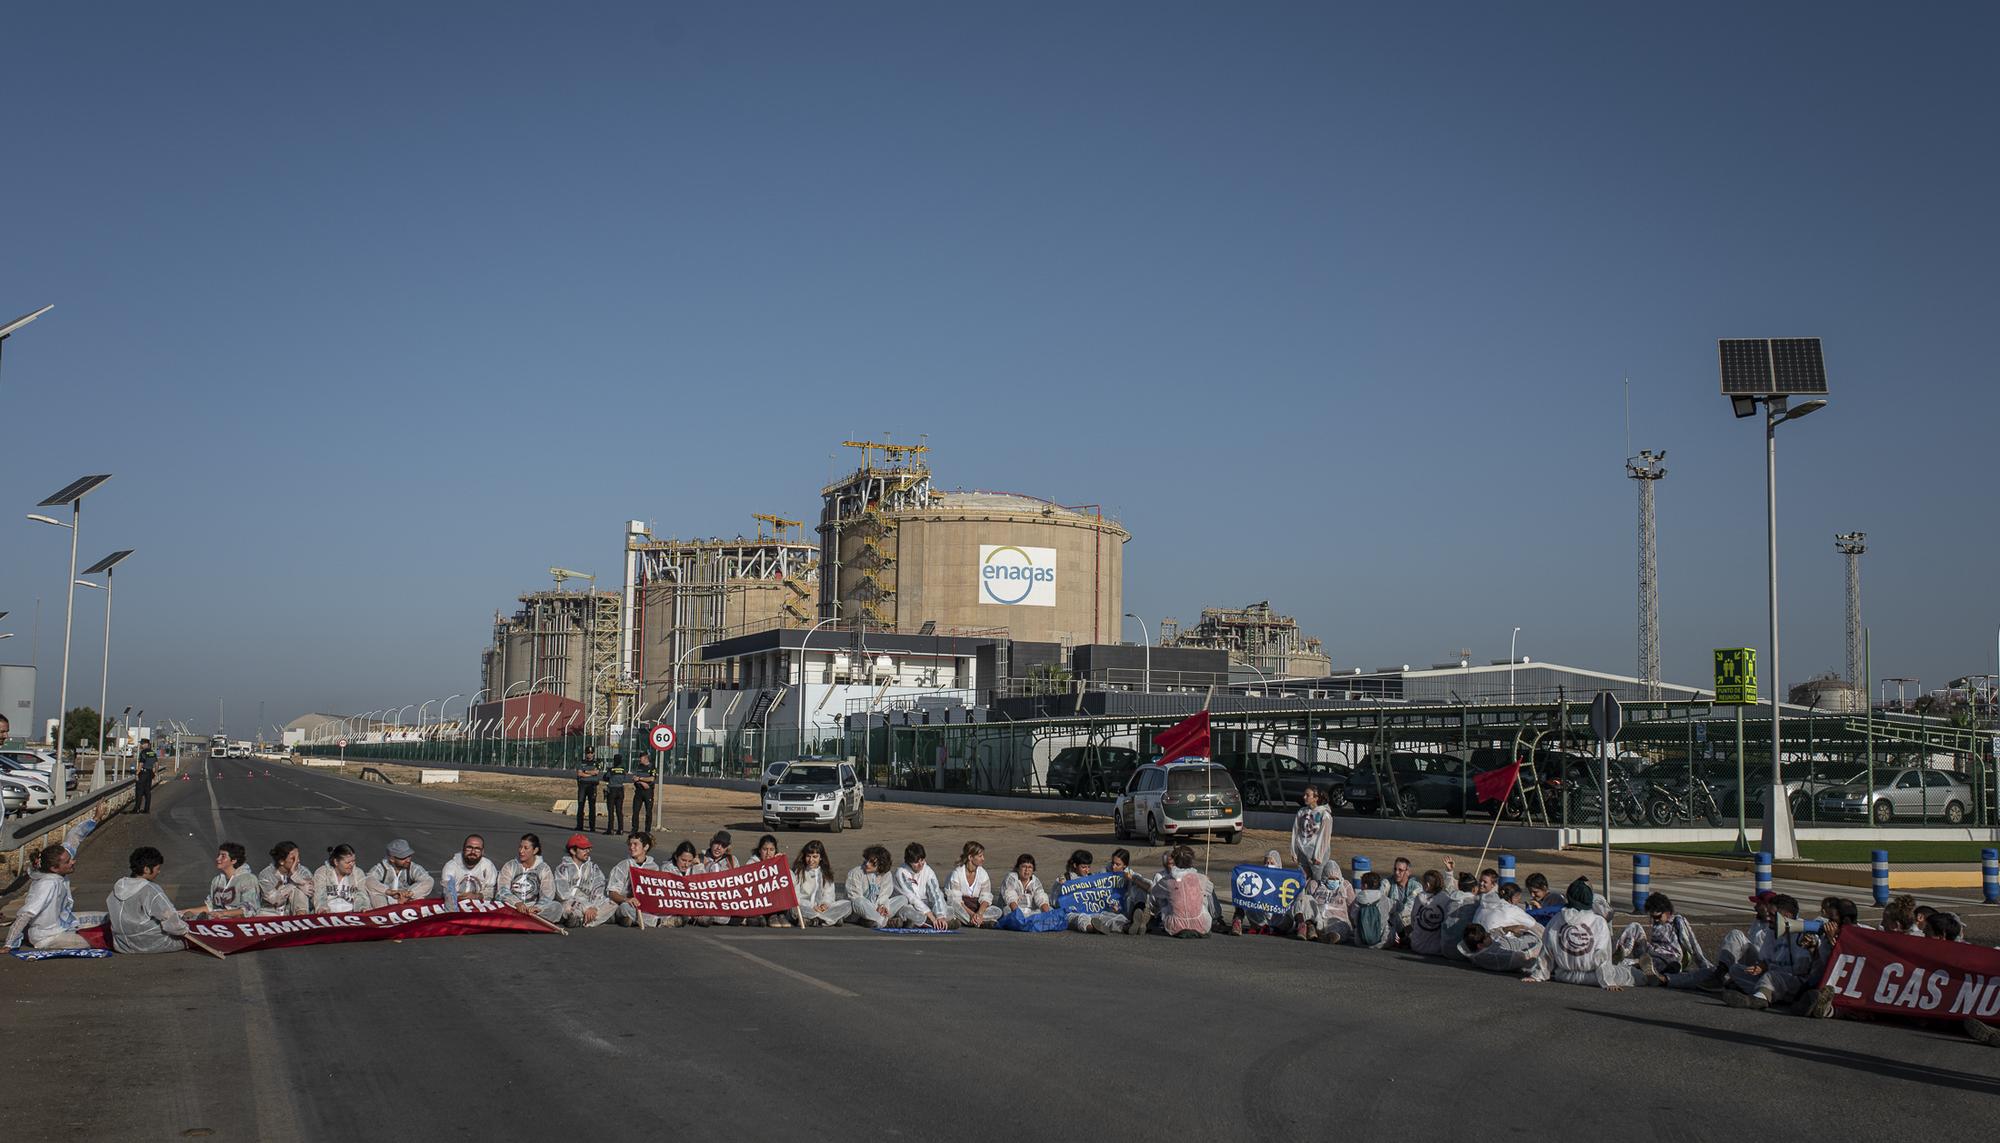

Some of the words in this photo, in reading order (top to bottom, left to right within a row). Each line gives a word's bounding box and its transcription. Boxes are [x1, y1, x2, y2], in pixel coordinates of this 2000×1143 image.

[983, 565, 1053, 582] enagas
[656, 733, 670, 742] 60
[635, 885, 644, 894] A
[647, 886, 665, 897] LA
[669, 888, 742, 901] INDUSTRIA
[744, 887, 754, 896] Y
[758, 875, 790, 895] MÁS
[639, 875, 685, 890] MENOS
[688, 864, 779, 891] SUBVENCIÓN
[658, 898, 719, 910] JUSTICIA
[721, 896, 773, 911] SOCIAL
[237, 915, 367, 937] FAMILIAS
[1826, 953, 1867, 999] EL
[1874, 962, 1950, 1010] GAS
